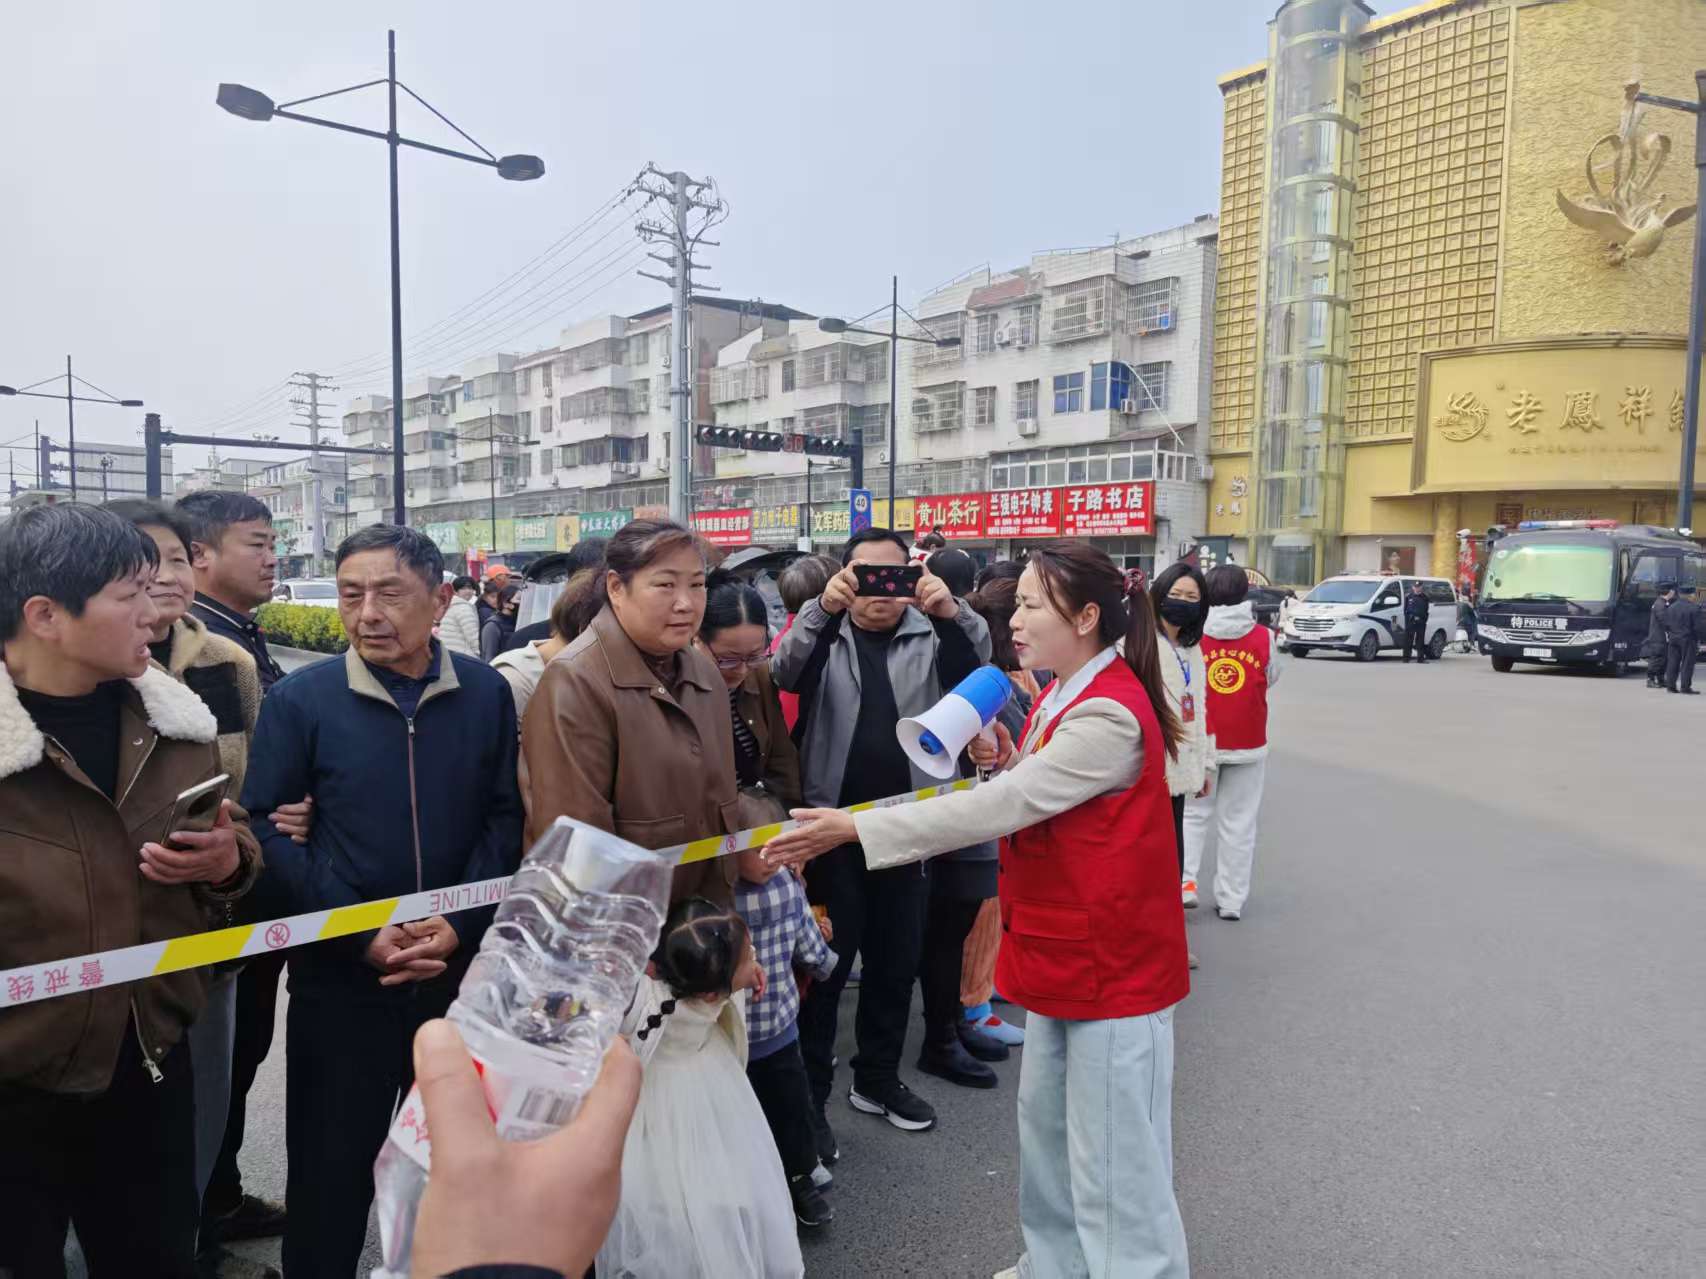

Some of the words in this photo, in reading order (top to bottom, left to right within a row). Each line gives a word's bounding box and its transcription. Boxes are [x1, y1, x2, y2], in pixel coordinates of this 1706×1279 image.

[1067, 485, 1144, 512] 子路书店
[916, 498, 980, 528] 黄山茶行
[1511, 614, 1523, 629] 特
[1523, 619, 1554, 627] POLICE
